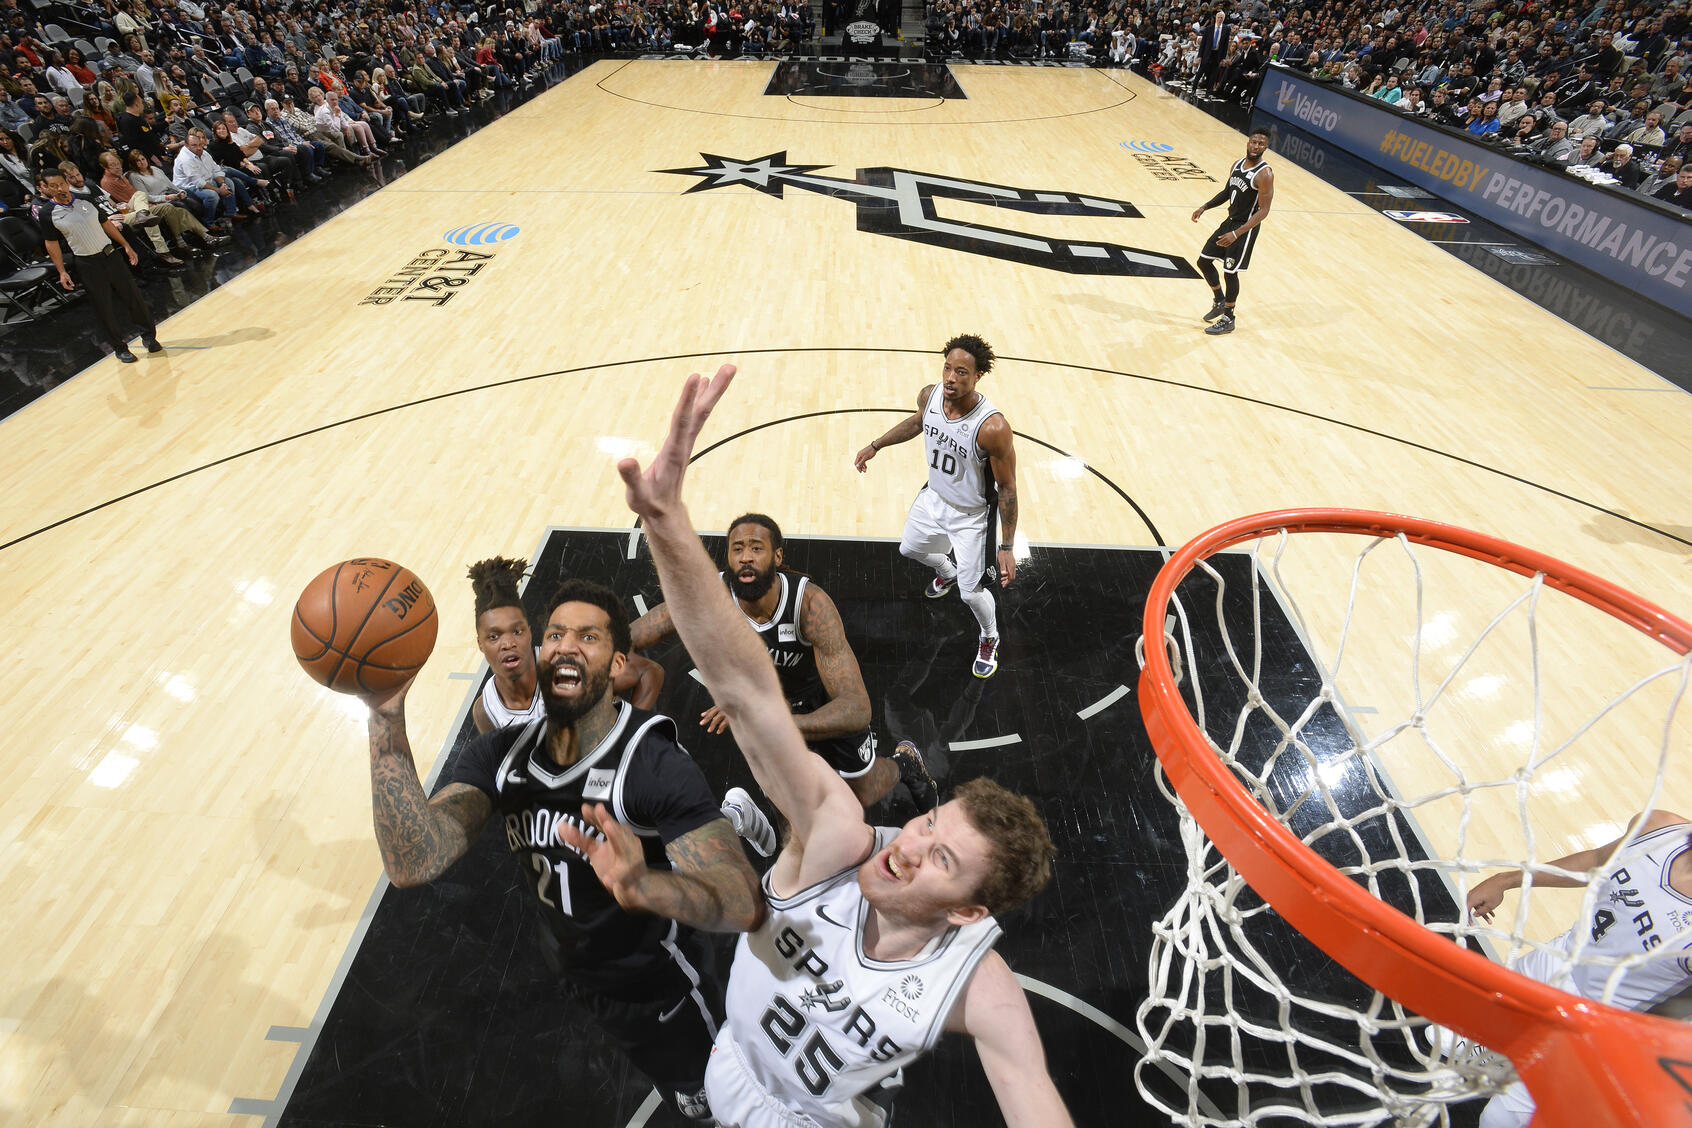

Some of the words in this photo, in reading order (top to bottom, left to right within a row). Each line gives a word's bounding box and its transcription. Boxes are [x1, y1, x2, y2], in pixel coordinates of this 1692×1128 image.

[732, 55, 927, 64] ANTONIO
[1294, 92, 1339, 132] Valero
[1153, 154, 1219, 183] AT&T
[1380, 129, 1490, 192] #FUELEDBY
[1482, 172, 1692, 288] PERFORMANCE
[357, 249, 450, 305] CENTER
[400, 249, 496, 306] AT&T
[924, 424, 967, 459] SPURS
[931, 449, 956, 475] 10
[588, 777, 610, 788] infor
[531, 852, 573, 918] 21
[1591, 909, 1617, 944] 4
[774, 926, 902, 1062] SPURS
[881, 986, 920, 1023] Frost
[758, 992, 848, 1098] 25
